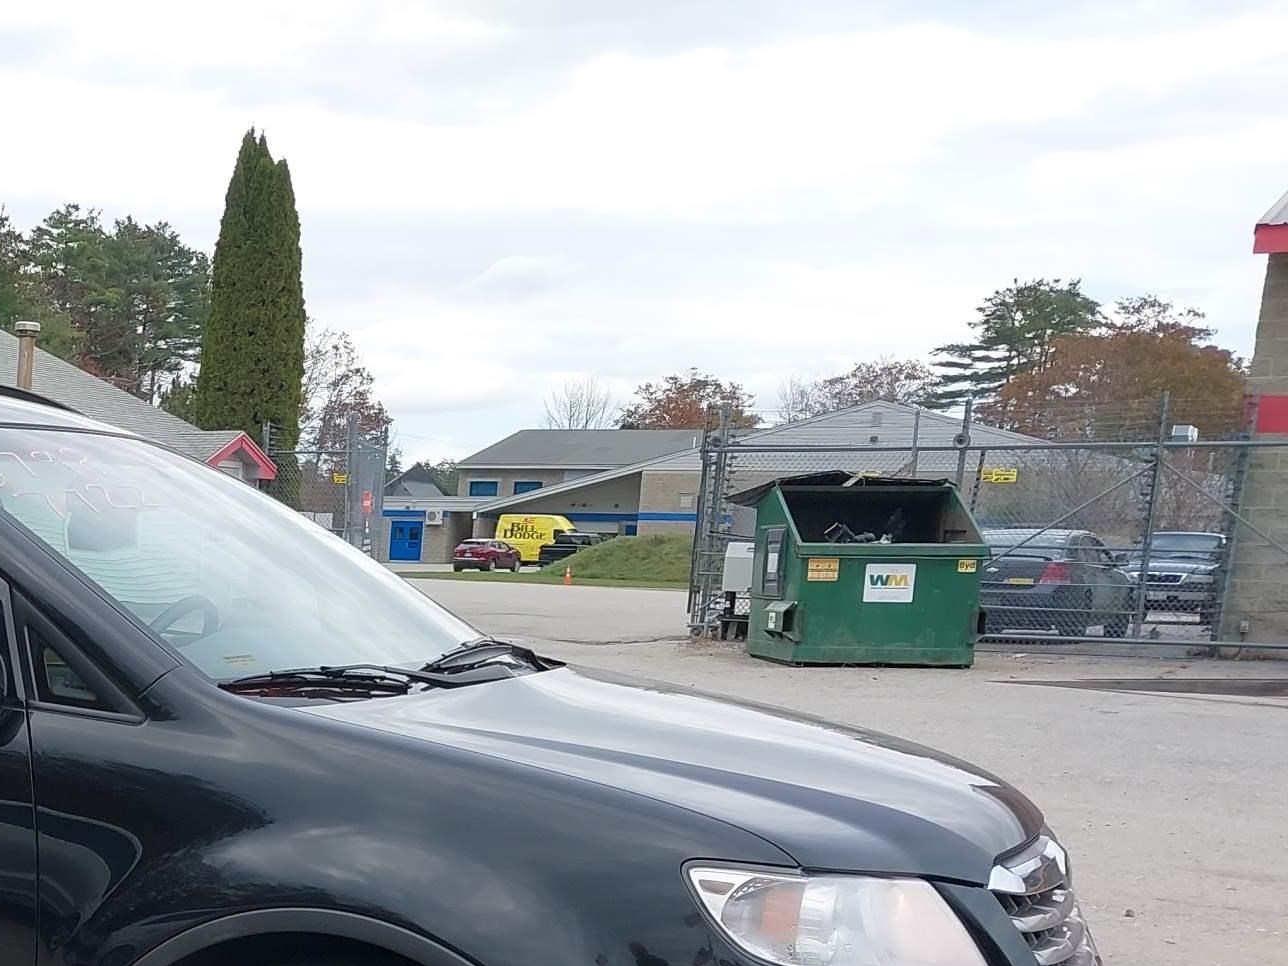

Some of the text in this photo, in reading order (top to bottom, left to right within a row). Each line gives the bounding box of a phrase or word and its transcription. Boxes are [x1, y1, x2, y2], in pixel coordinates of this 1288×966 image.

[511, 522, 536, 533] BILL
[503, 529, 546, 540] DODGE
[869, 574, 909, 586] WM
